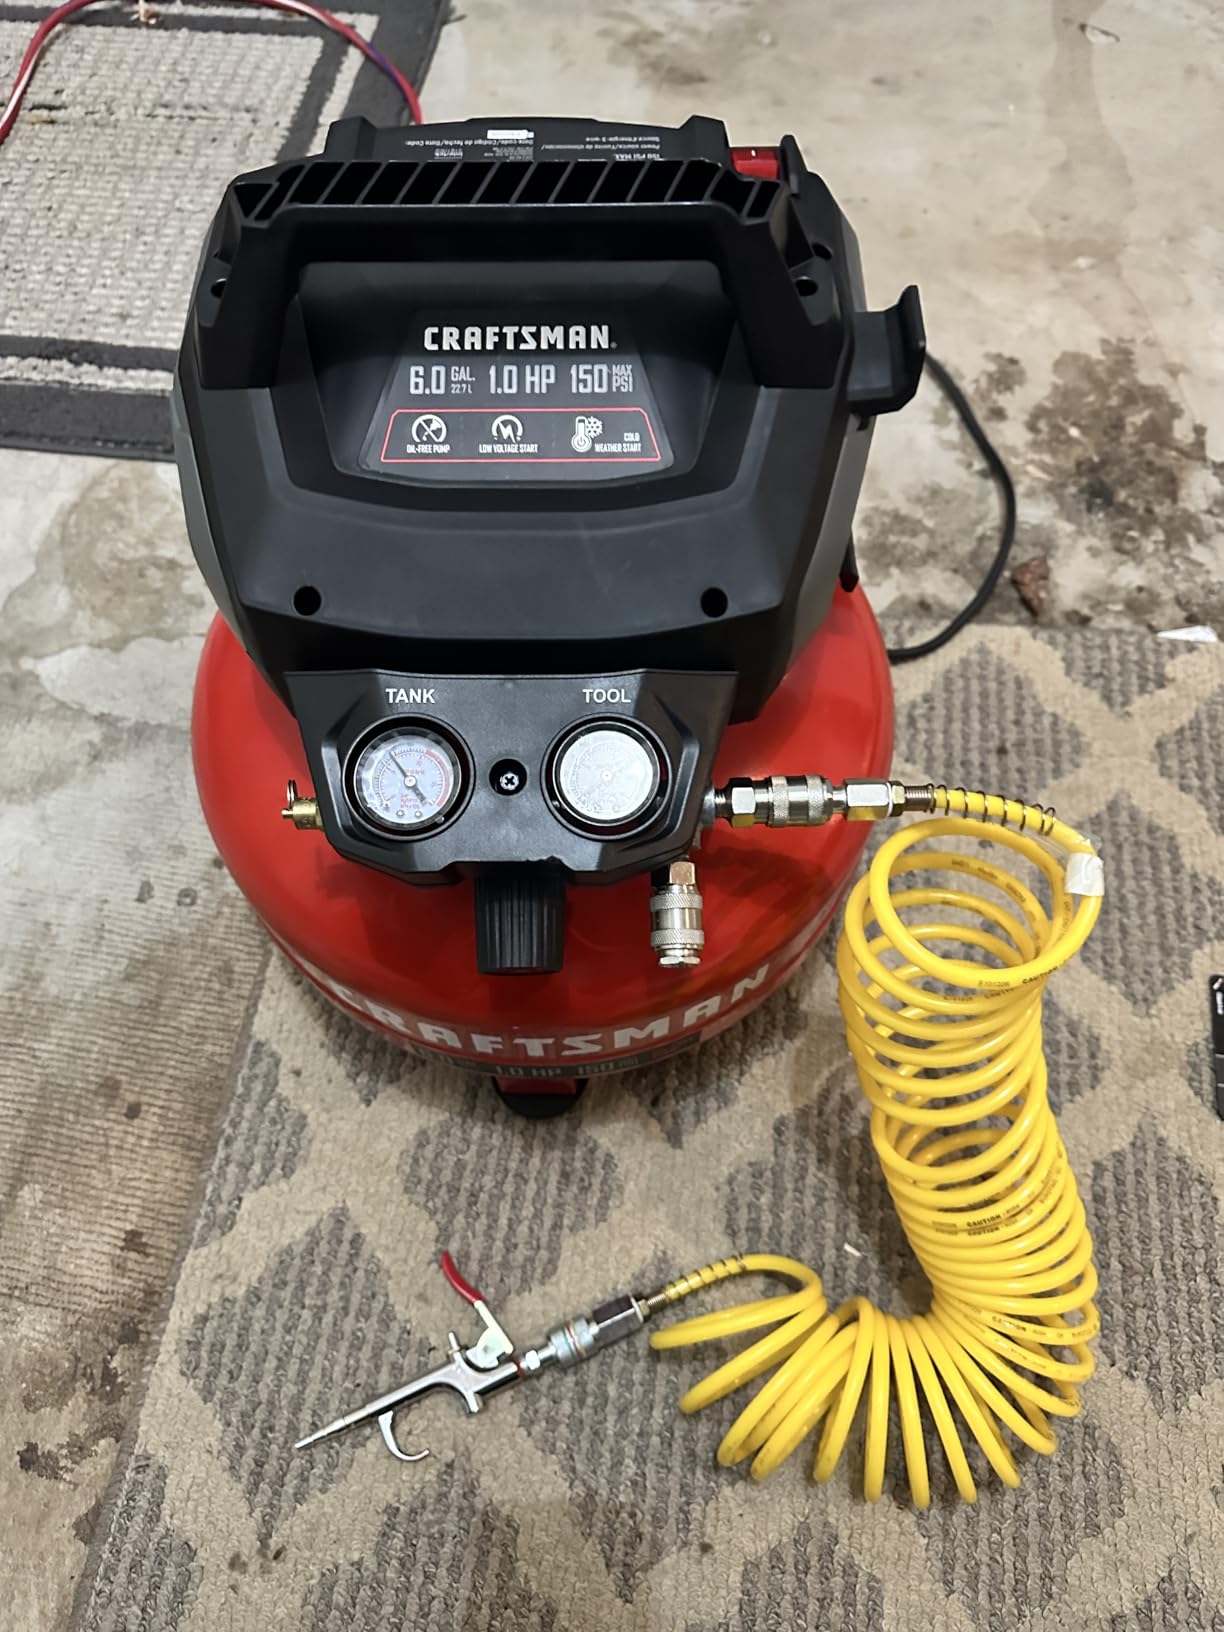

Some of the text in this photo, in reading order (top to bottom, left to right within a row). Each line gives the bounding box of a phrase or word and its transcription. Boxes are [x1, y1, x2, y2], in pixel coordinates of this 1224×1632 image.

[409, 365, 475, 395] 6.0 GAL.
[489, 364, 556, 394] 1.0 HP
[570, 364, 632, 393] 150 MAX
[612, 376, 633, 392] PSI
[624, 432, 640, 442] COLD
[406, 444, 450, 454] OIL-FREE PUMP
[479, 444, 538, 453] LOW VOLTAGE START
[595, 443, 642, 453] WEATHER START
[386, 688, 435, 704] TANK
[582, 688, 632, 704] TOOL
[966, 1214, 1001, 1228] CAUTION
